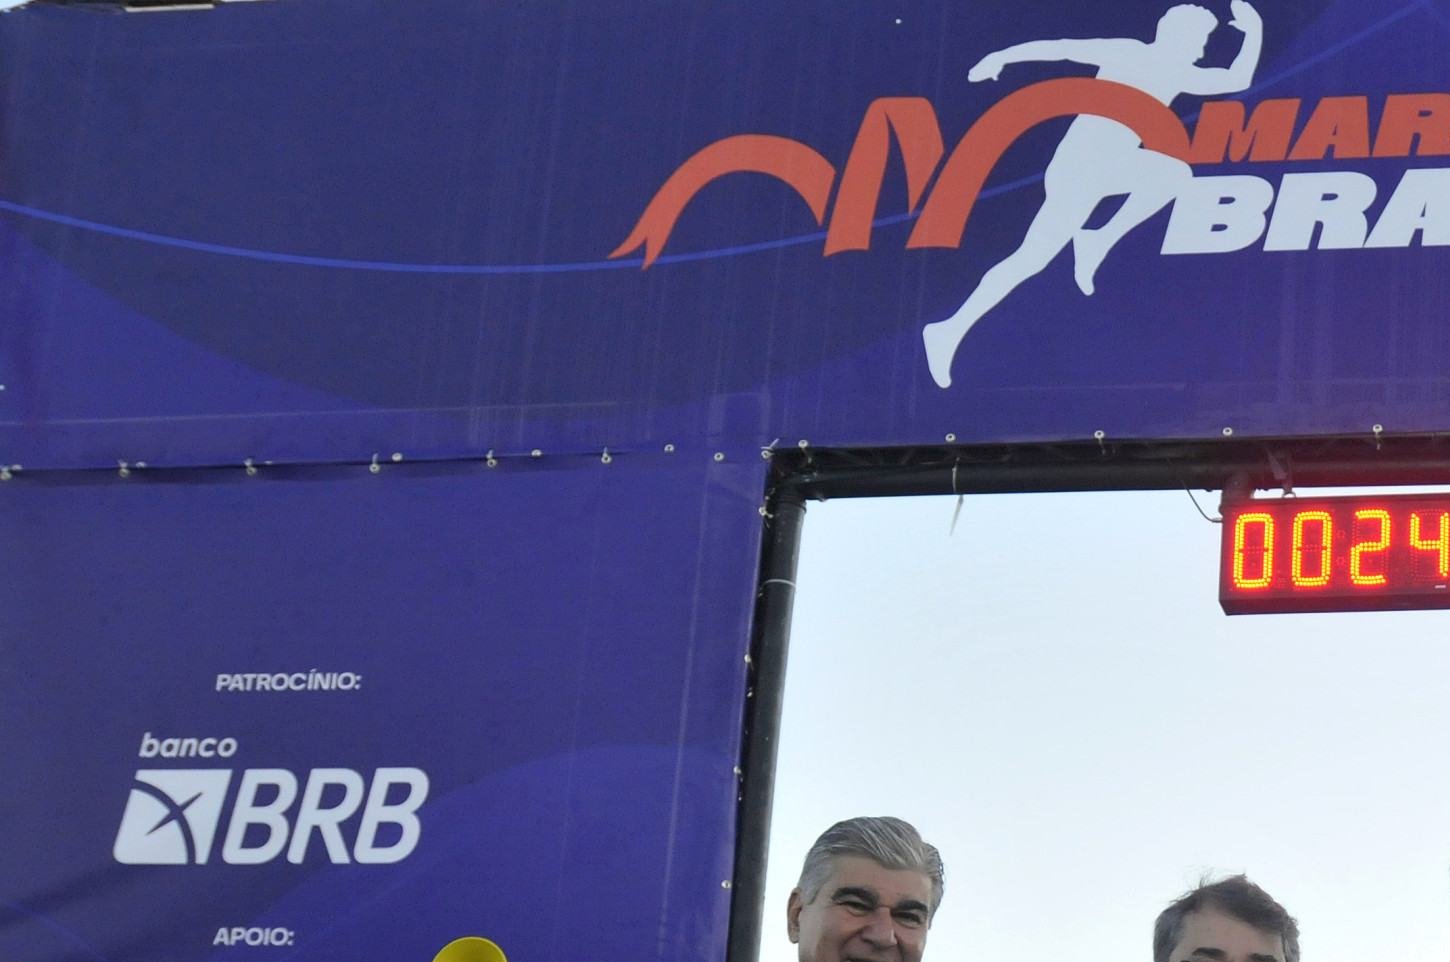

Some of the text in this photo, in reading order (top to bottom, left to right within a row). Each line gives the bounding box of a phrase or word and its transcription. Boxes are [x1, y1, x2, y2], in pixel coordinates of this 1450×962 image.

[215, 669, 362, 691] PATROCÍNIO:
[139, 733, 238, 758] banco
[222, 767, 430, 864] BRB
[213, 928, 294, 946] APOIO:
